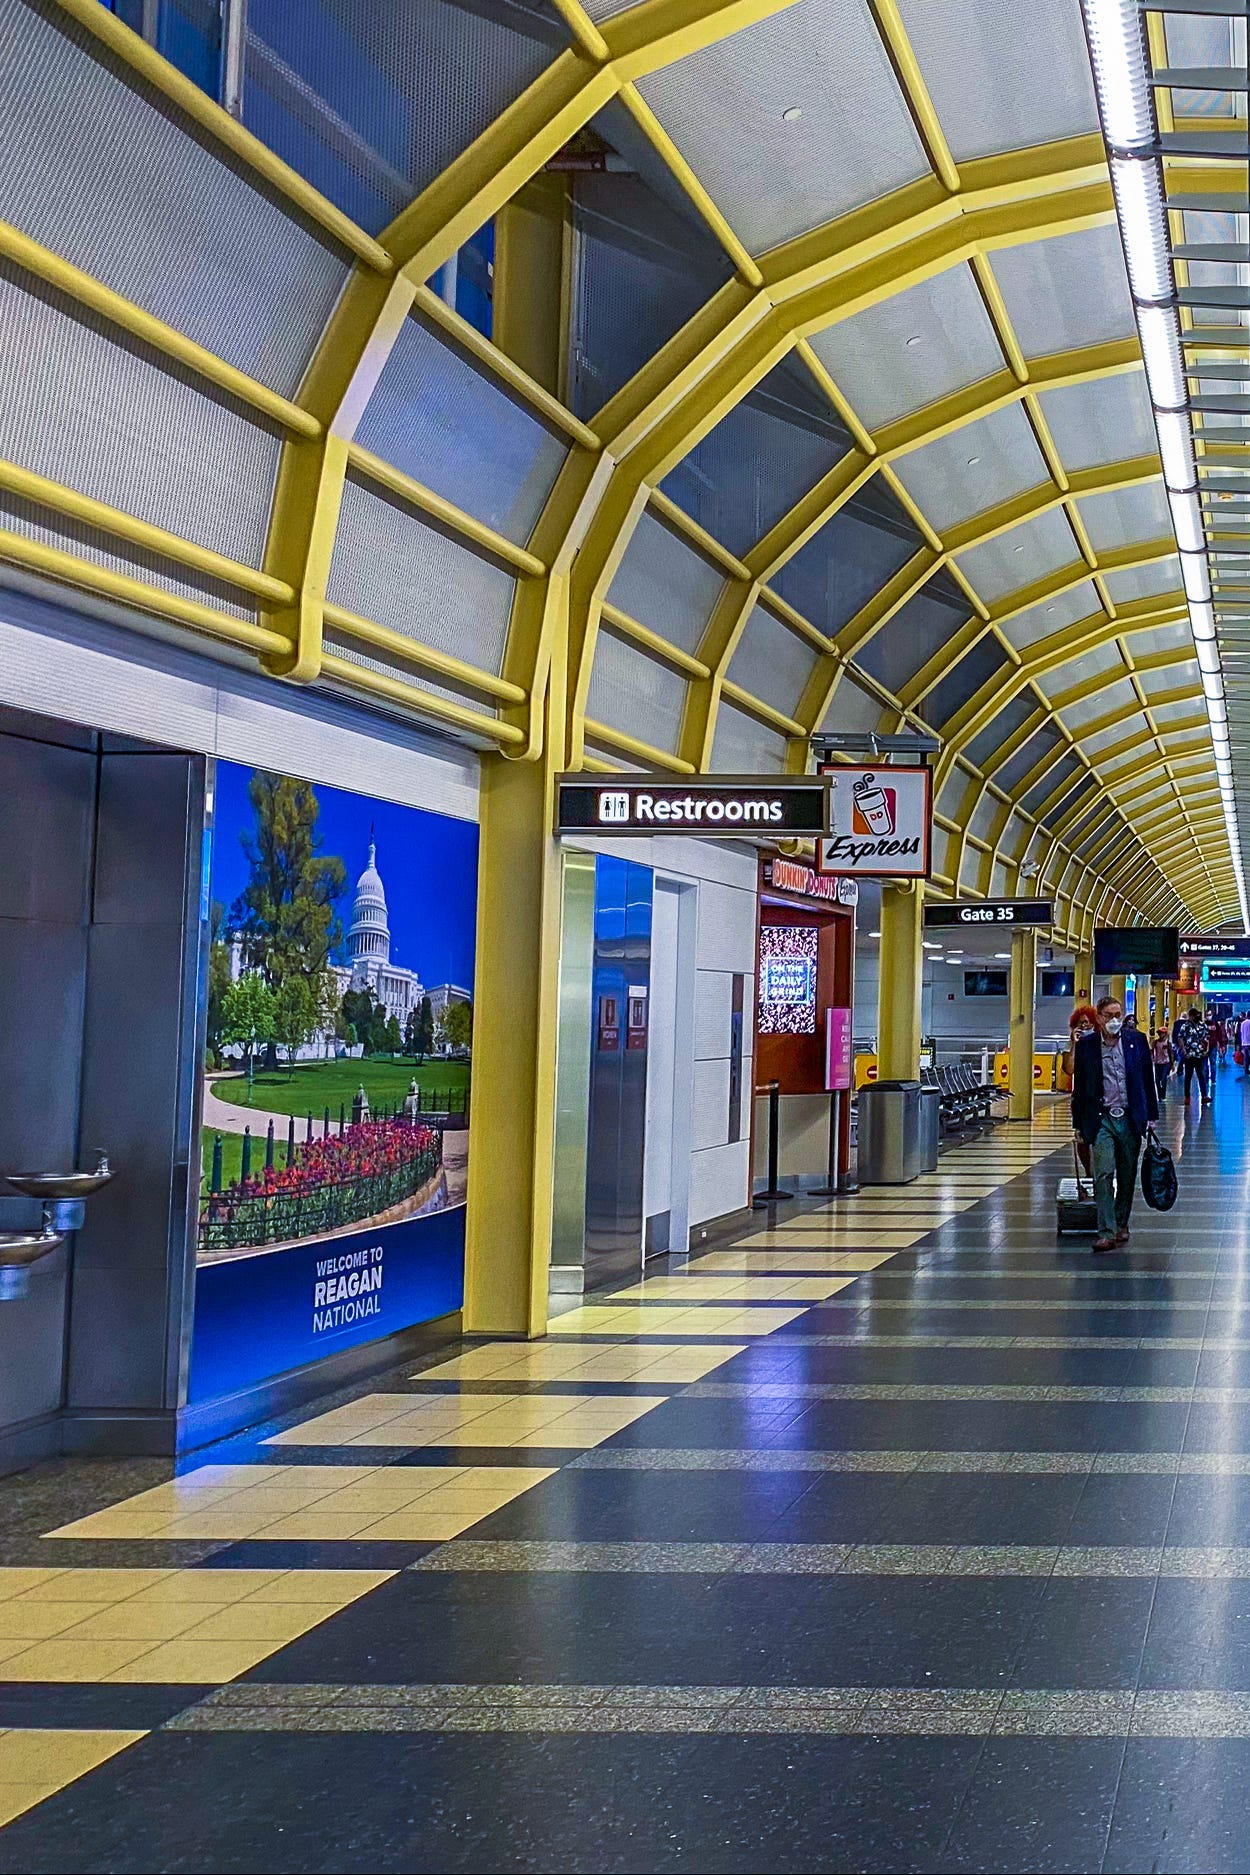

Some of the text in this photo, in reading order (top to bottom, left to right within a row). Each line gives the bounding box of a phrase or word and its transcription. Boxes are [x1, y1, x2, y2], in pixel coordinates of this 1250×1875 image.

[636, 794, 783, 821] Restrooms
[869, 811, 884, 821] DD
[825, 835, 921, 866] Express
[806, 868, 839, 901] DONUTS
[960, 907, 1014, 921] Gate 35
[771, 976, 803, 985] DAILY
[316, 1246, 384, 1277] WELCOME TO
[314, 1265, 383, 1308] REAGAN
[312, 1294, 381, 1334] NATIONAL
